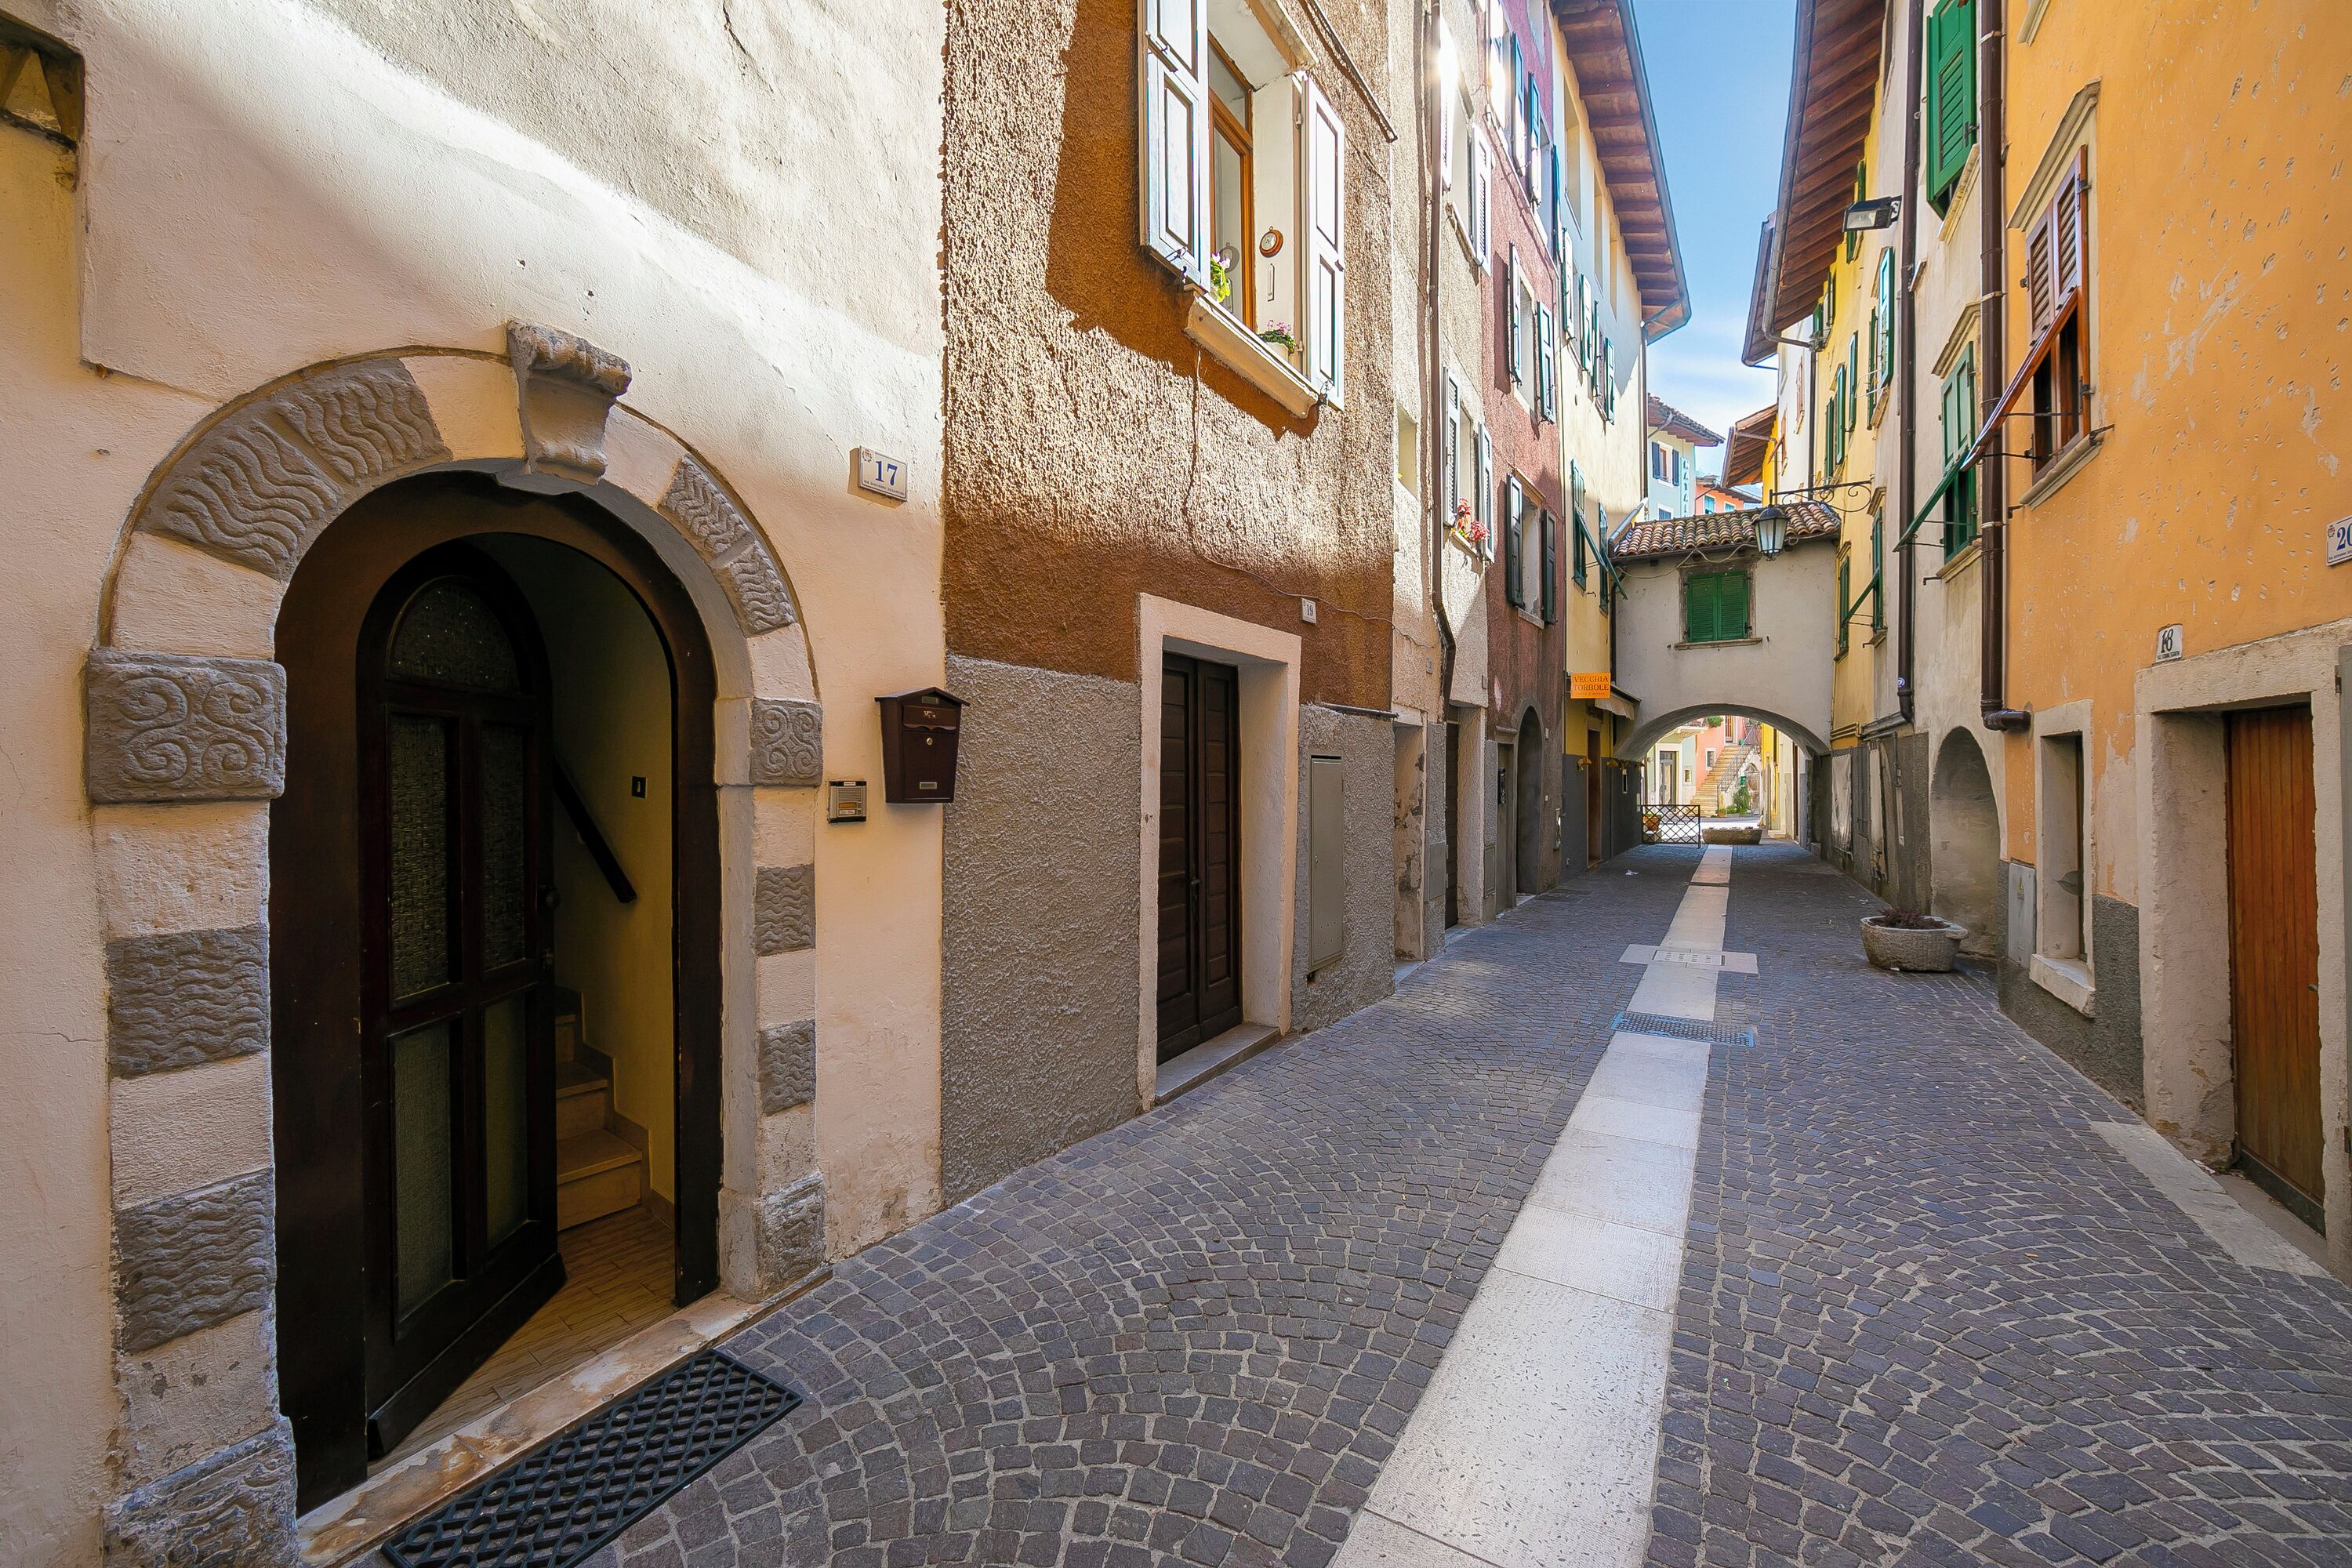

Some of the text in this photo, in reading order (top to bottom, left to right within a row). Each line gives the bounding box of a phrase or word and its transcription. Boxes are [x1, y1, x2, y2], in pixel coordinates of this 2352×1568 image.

[875, 460, 898, 486] 17
[1306, 604, 1313, 616] 19
[2161, 628, 2174, 653] 18
